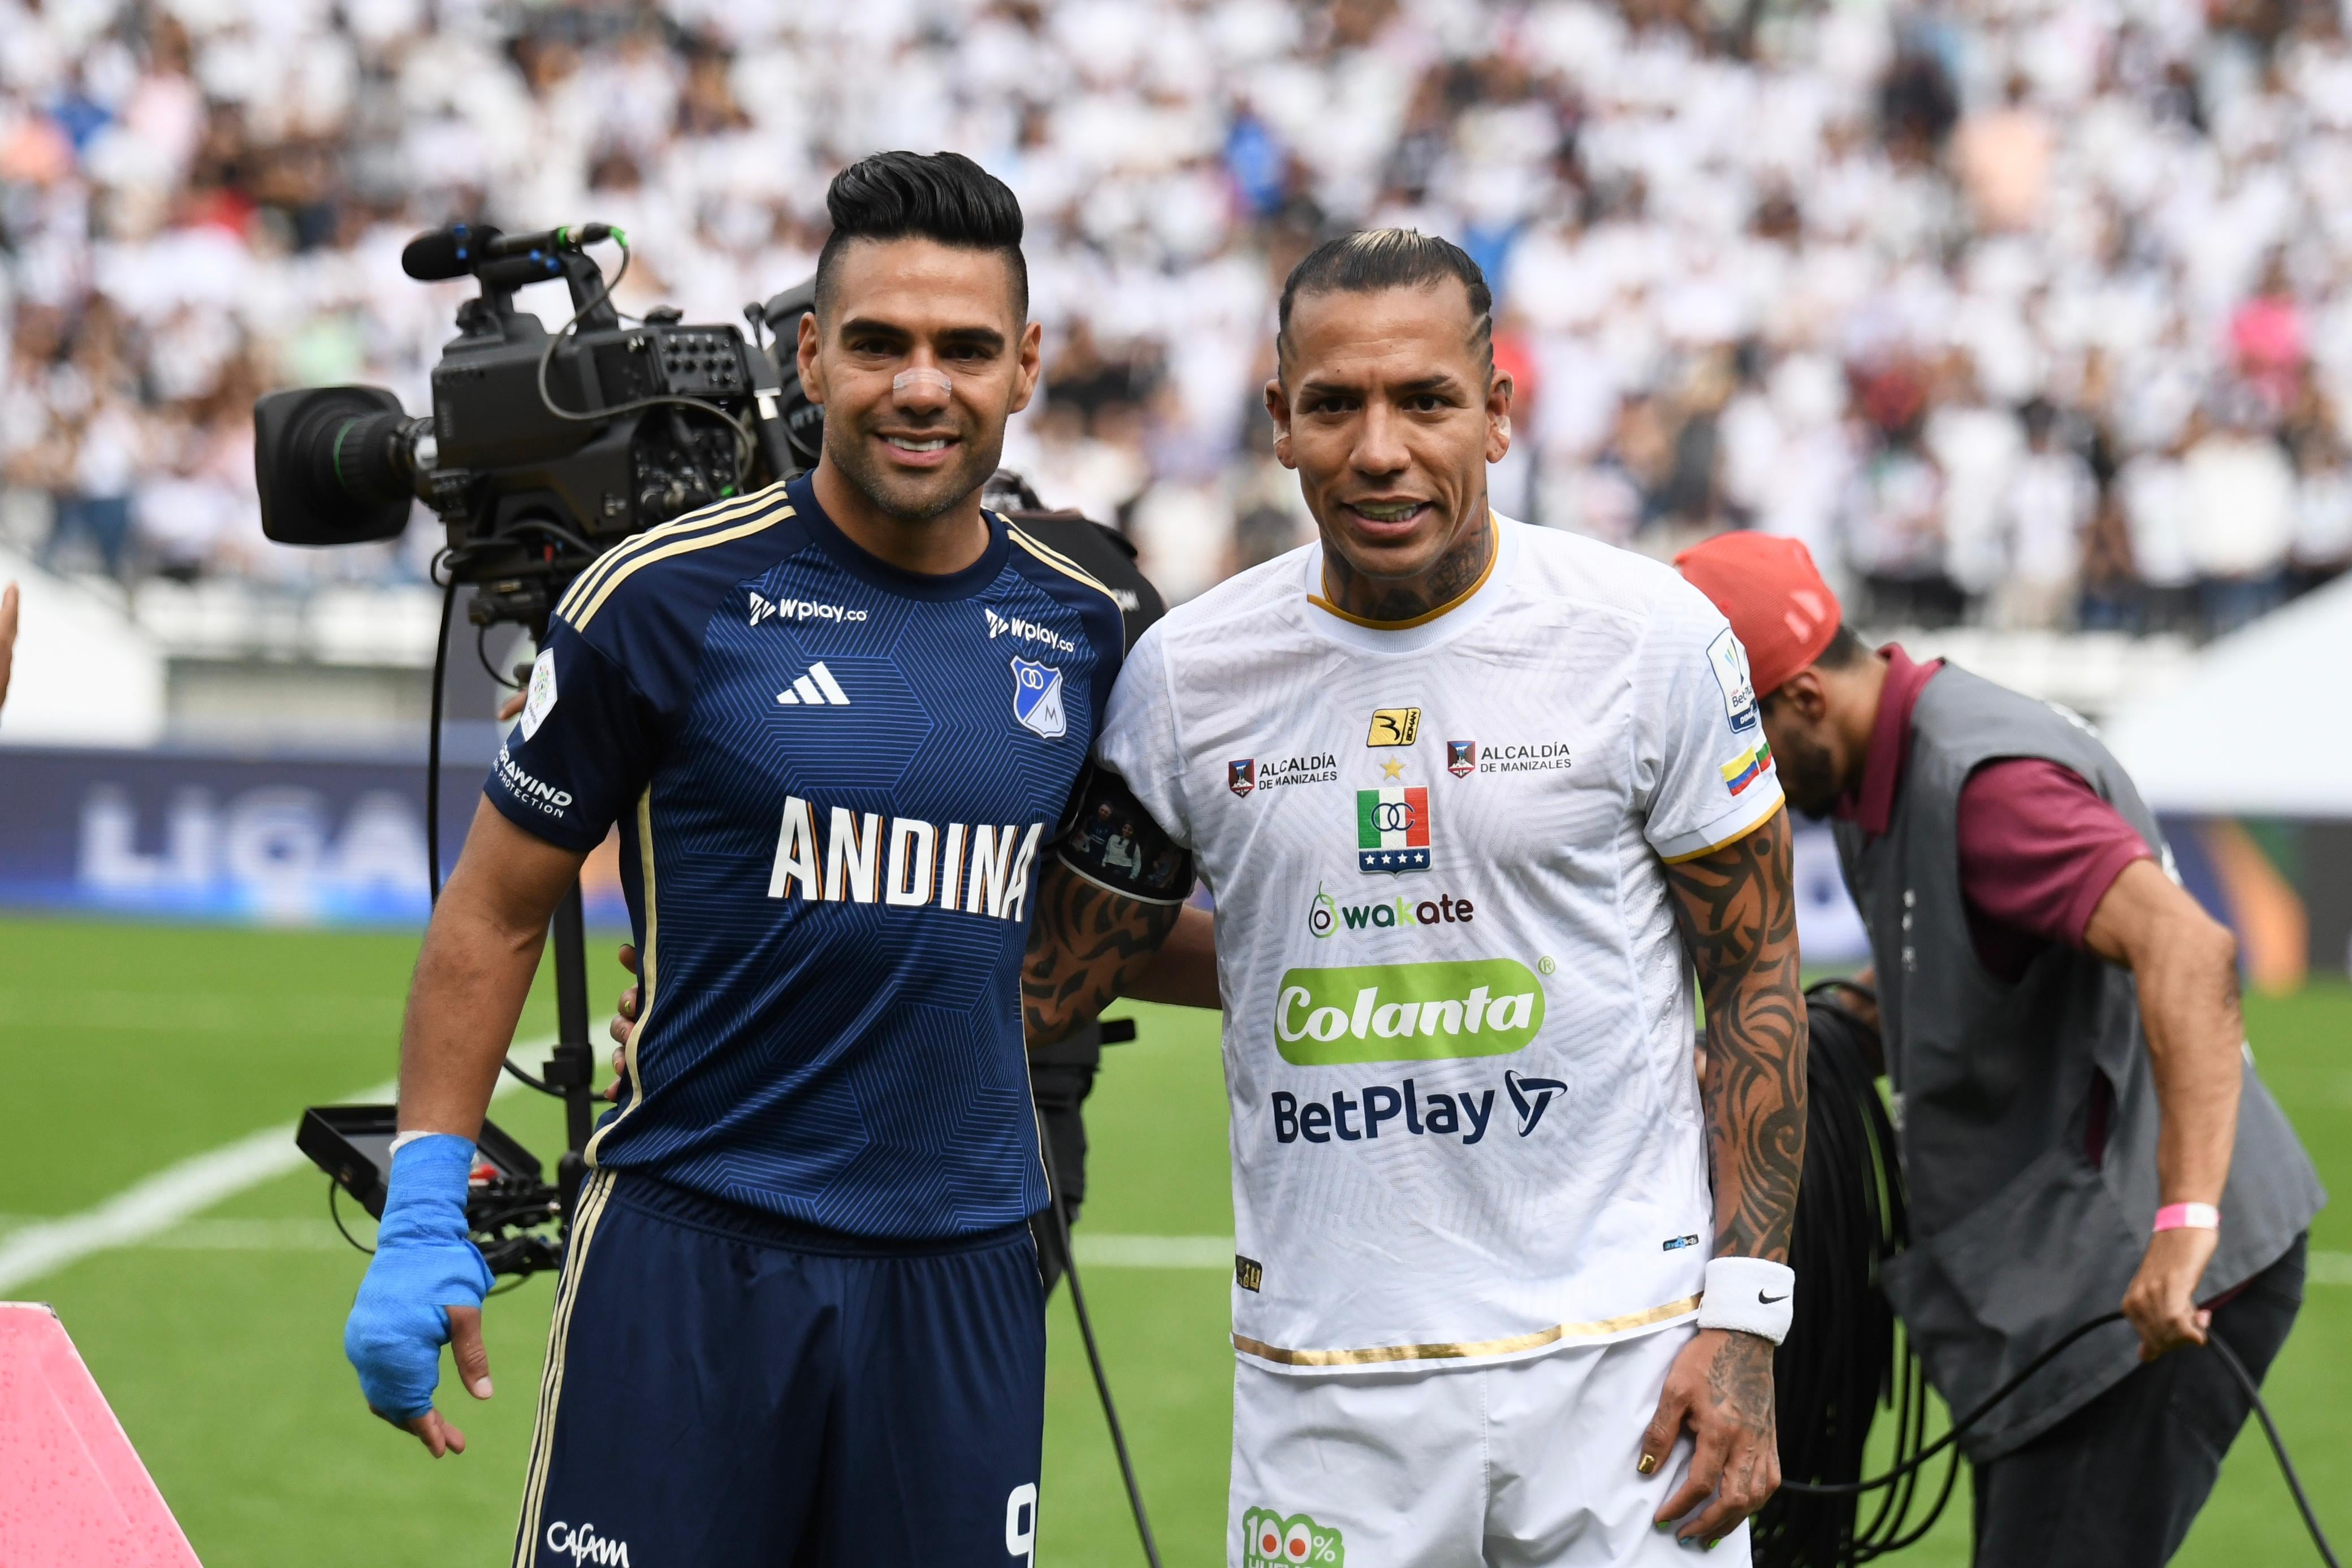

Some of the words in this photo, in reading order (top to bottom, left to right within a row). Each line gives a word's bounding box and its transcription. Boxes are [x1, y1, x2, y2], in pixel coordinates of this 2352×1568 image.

[780, 599, 867, 623] Wplay.co
[1011, 617, 1074, 652] Wplay.co
[1732, 686, 1753, 708] BetPla
[1260, 752, 1337, 777] ALCALDÍA
[1480, 763, 1497, 773] DE
[1501, 759, 1571, 772] MANIZALES
[1481, 742, 1570, 760] ALCALDÍA
[1259, 779, 1273, 790] DE
[1274, 771, 1337, 787] MANIZALES
[78, 787, 434, 887] LIGA
[768, 795, 1045, 922] ANDINA
[1276, 986, 1534, 1042] Colanta
[1272, 1078, 1495, 1145] BetPlay
[1006, 1482, 1037, 1568] 9
[1247, 1515, 1335, 1564] 100%
